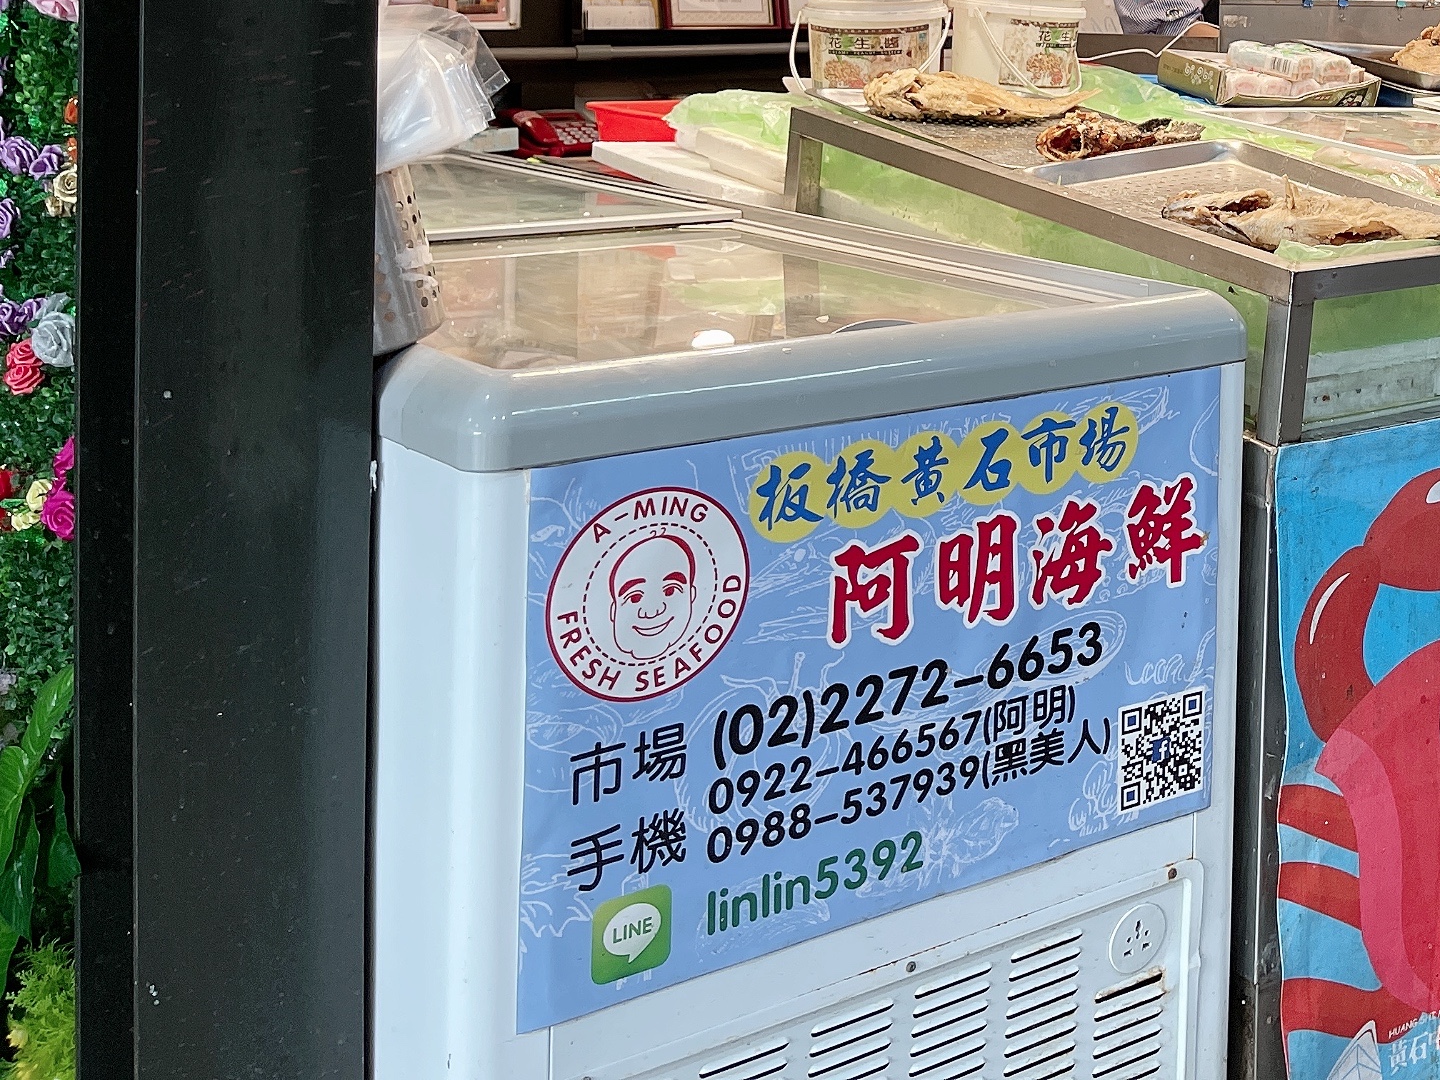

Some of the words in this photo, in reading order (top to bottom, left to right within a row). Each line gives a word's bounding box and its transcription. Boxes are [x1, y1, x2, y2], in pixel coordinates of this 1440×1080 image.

[592, 496, 709, 544] A-MING
[755, 405, 1132, 527] 板橋黃石市場
[830, 477, 1203, 644] 阿明海鮮
[556, 610, 622, 691] FRESH
[634, 574, 742, 692] SEAFOOD
[570, 722, 688, 805] 市場
[712, 621, 1105, 771] (02)2272-6653
[566, 808, 689, 892] 手機
[611, 915, 654, 947] LINE
[706, 830, 924, 937] linlin5392
